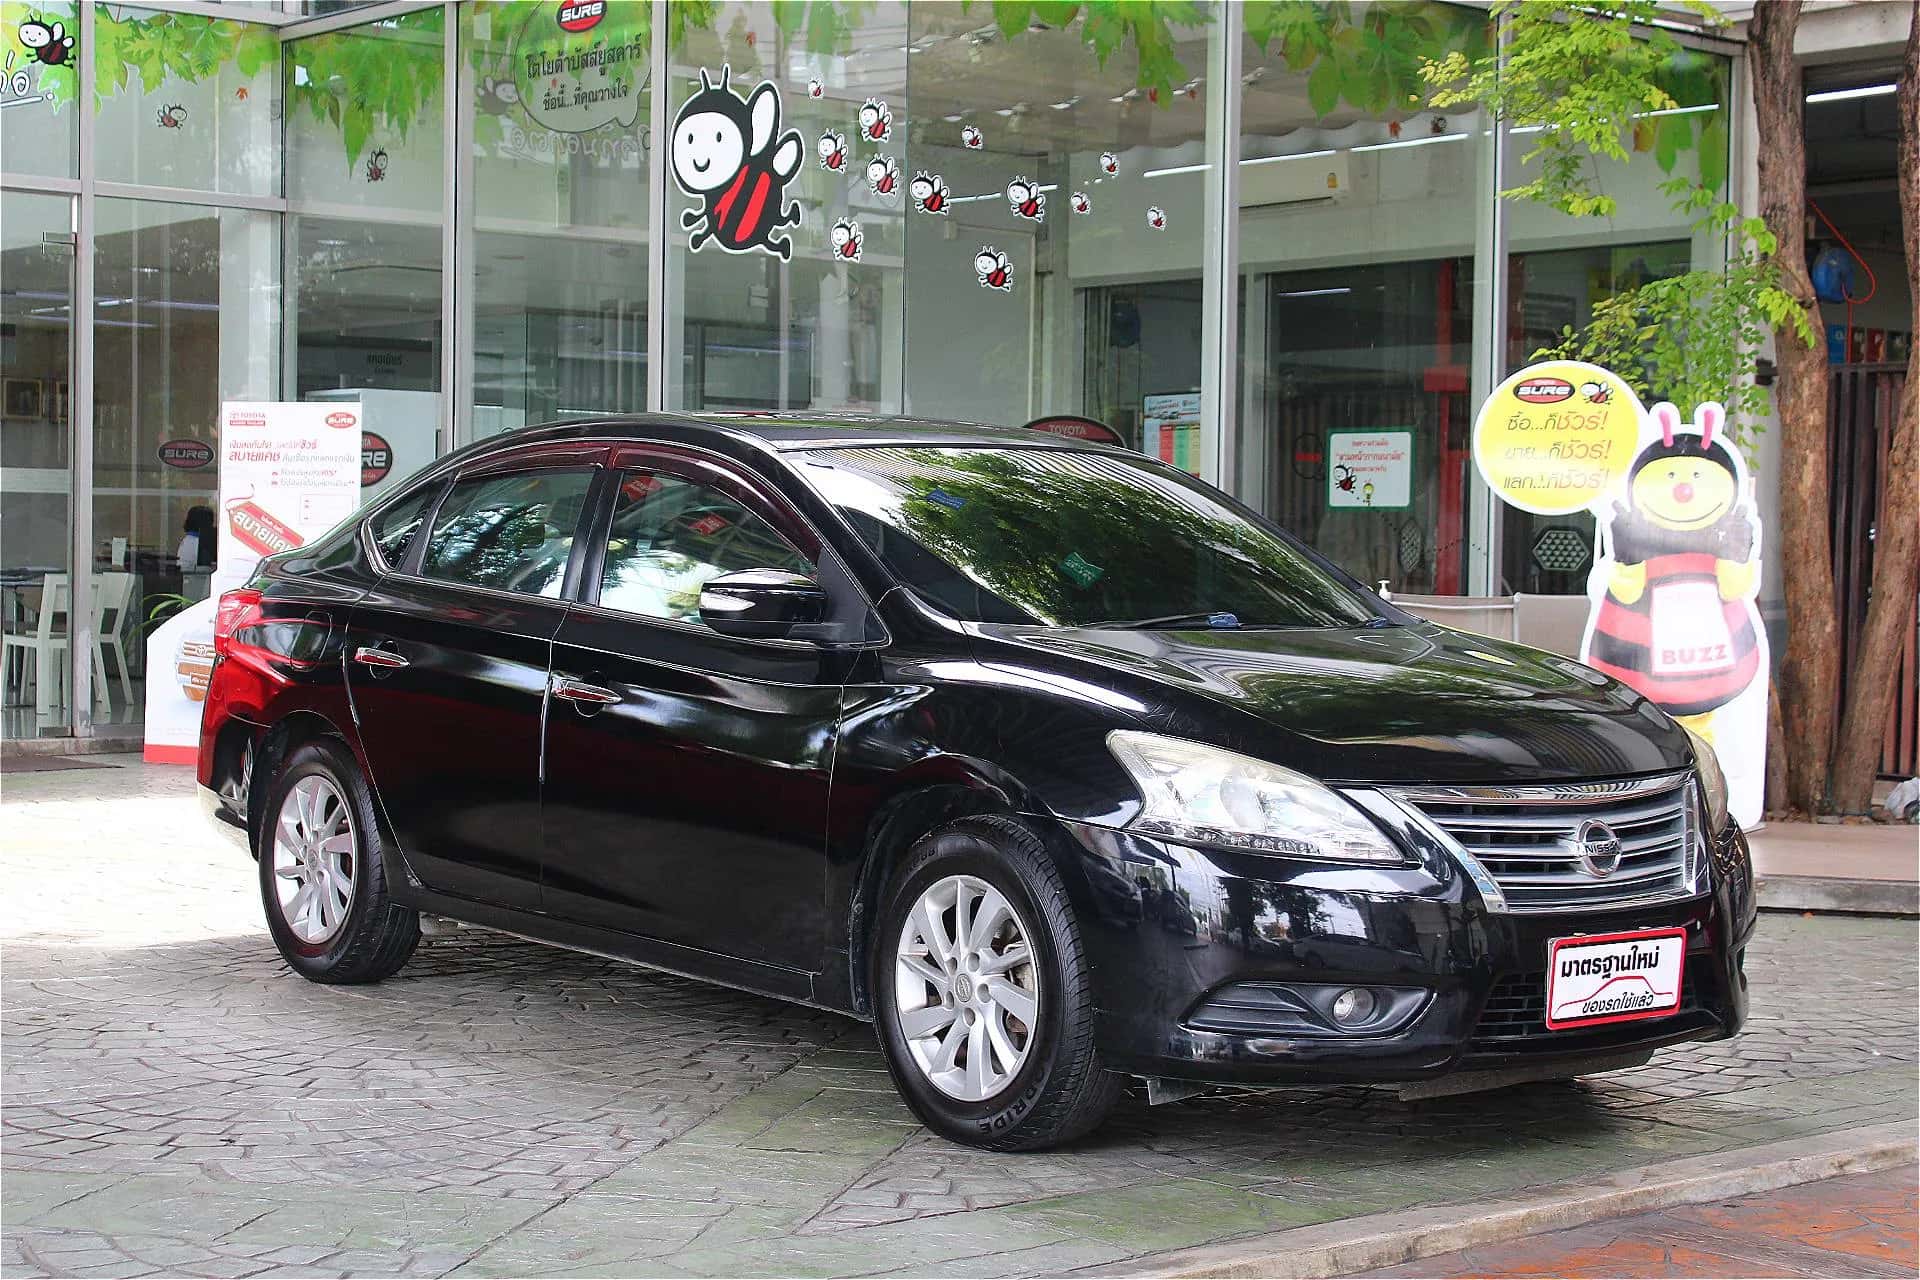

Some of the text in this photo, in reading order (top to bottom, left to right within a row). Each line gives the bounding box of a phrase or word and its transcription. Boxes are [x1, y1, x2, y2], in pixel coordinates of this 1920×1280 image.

[561, 2, 602, 22] SURE
[1518, 385, 1571, 396] SURE
[1049, 424, 1087, 436] TOYOTA
[164, 449, 209, 459] SURE
[362, 451, 386, 468] RE
[233, 511, 294, 552] สบายแค
[1662, 644, 1728, 665] BUZZ
[1561, 945, 1660, 979] มาตรฐานใหม่
[1582, 990, 1654, 1014] ของรถใช้แล้ว
